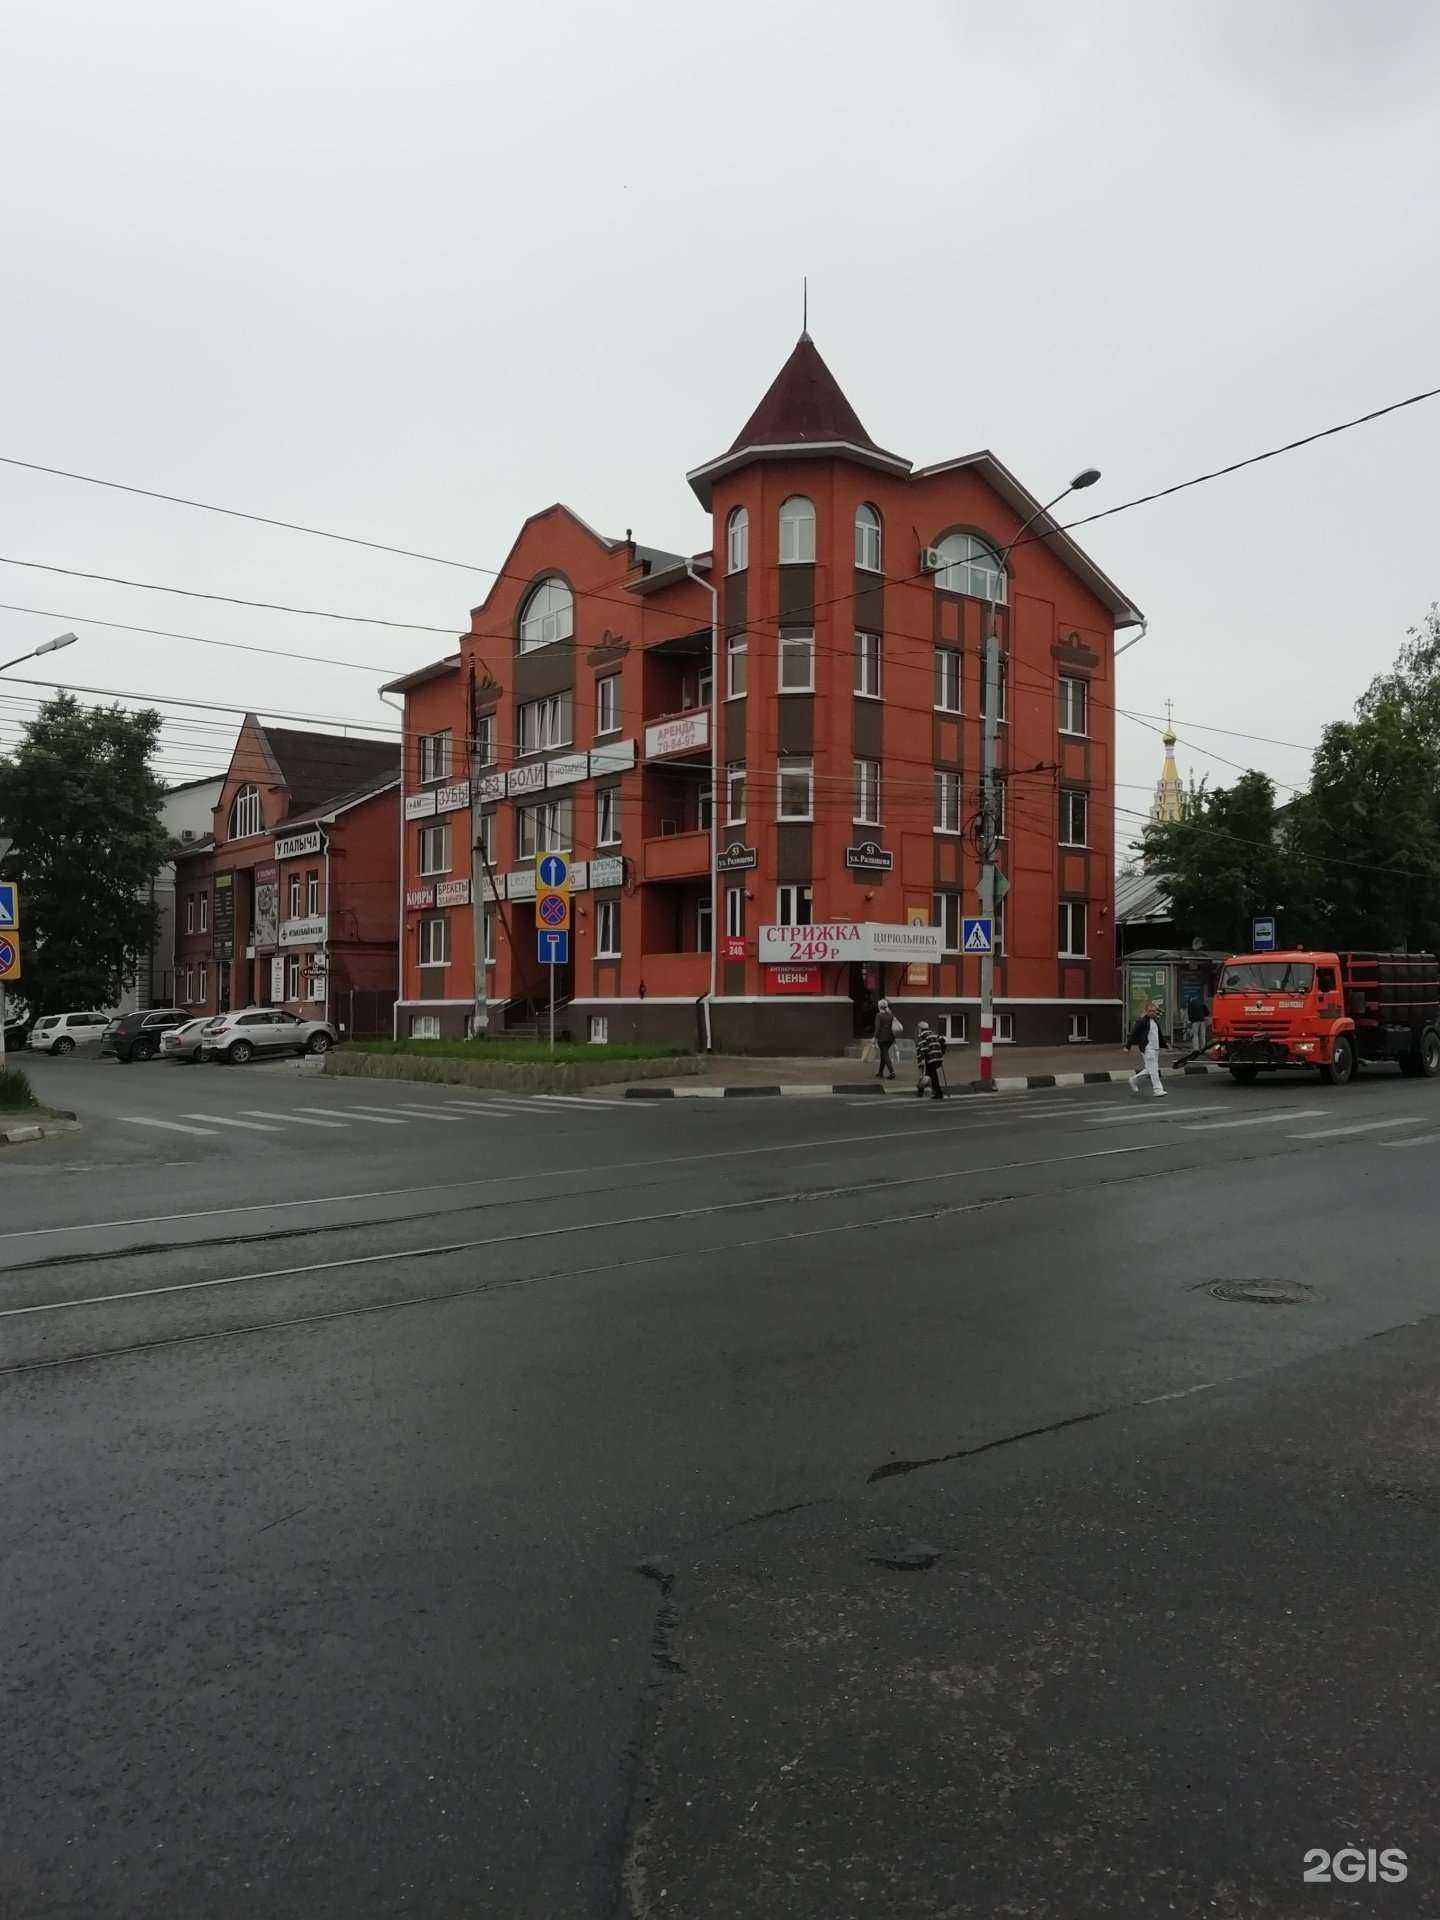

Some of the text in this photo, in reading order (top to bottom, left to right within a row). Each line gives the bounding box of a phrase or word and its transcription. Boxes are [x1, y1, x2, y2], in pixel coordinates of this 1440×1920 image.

[508, 764, 544, 789] БОЛИ
[283, 834, 318, 854] ПАЛЫЧА
[866, 846, 875, 855] 53
[406, 889, 434, 907] КОВРЫ
[766, 926, 861, 943] СТРИЖКА
[873, 932, 938, 946] ЦИРЮЛЬНИКЪ
[789, 942, 829, 961] 249
[777, 973, 809, 984] ЦЕНЫ
